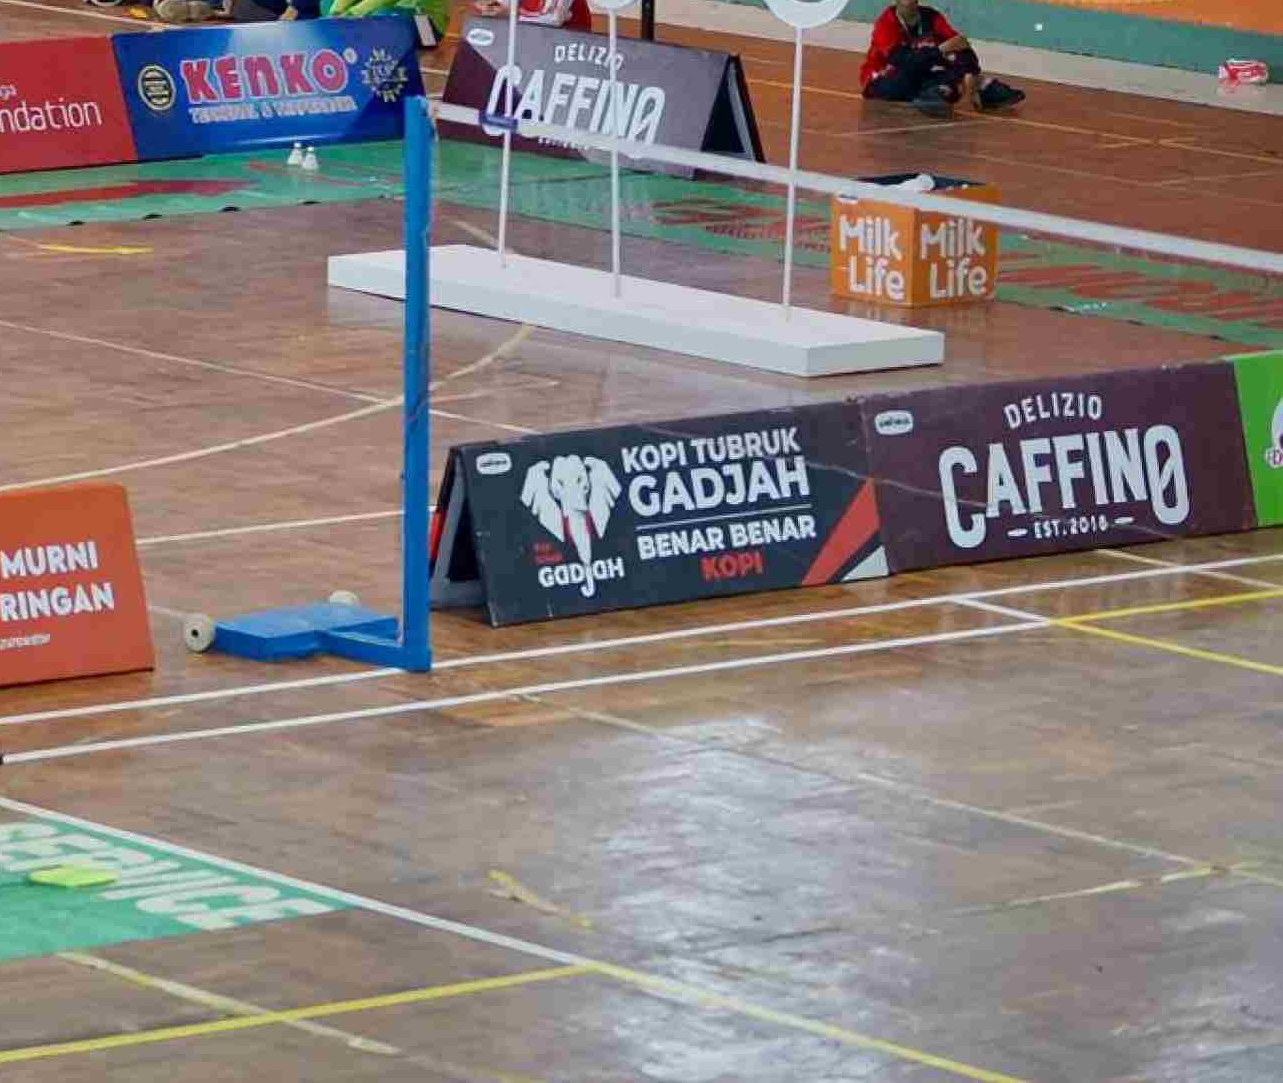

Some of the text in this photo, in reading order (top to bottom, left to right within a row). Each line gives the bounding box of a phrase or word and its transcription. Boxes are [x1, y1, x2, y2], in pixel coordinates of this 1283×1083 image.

[181, 48, 348, 104] KENKO
[839, 215, 903, 261] Milk
[921, 217, 986, 260] Milk
[849, 254, 905, 300] Life
[930, 258, 987, 298] Life
[1004, 392, 1103, 430] DELIZIO
[621, 427, 801, 474] KOPI TUBRUK
[628, 455, 811, 517] GADJAH
[0, 540, 98, 580] MURNI
[637, 515, 817, 561] BENAR BENAR
[700, 552, 762, 582] KOPI
